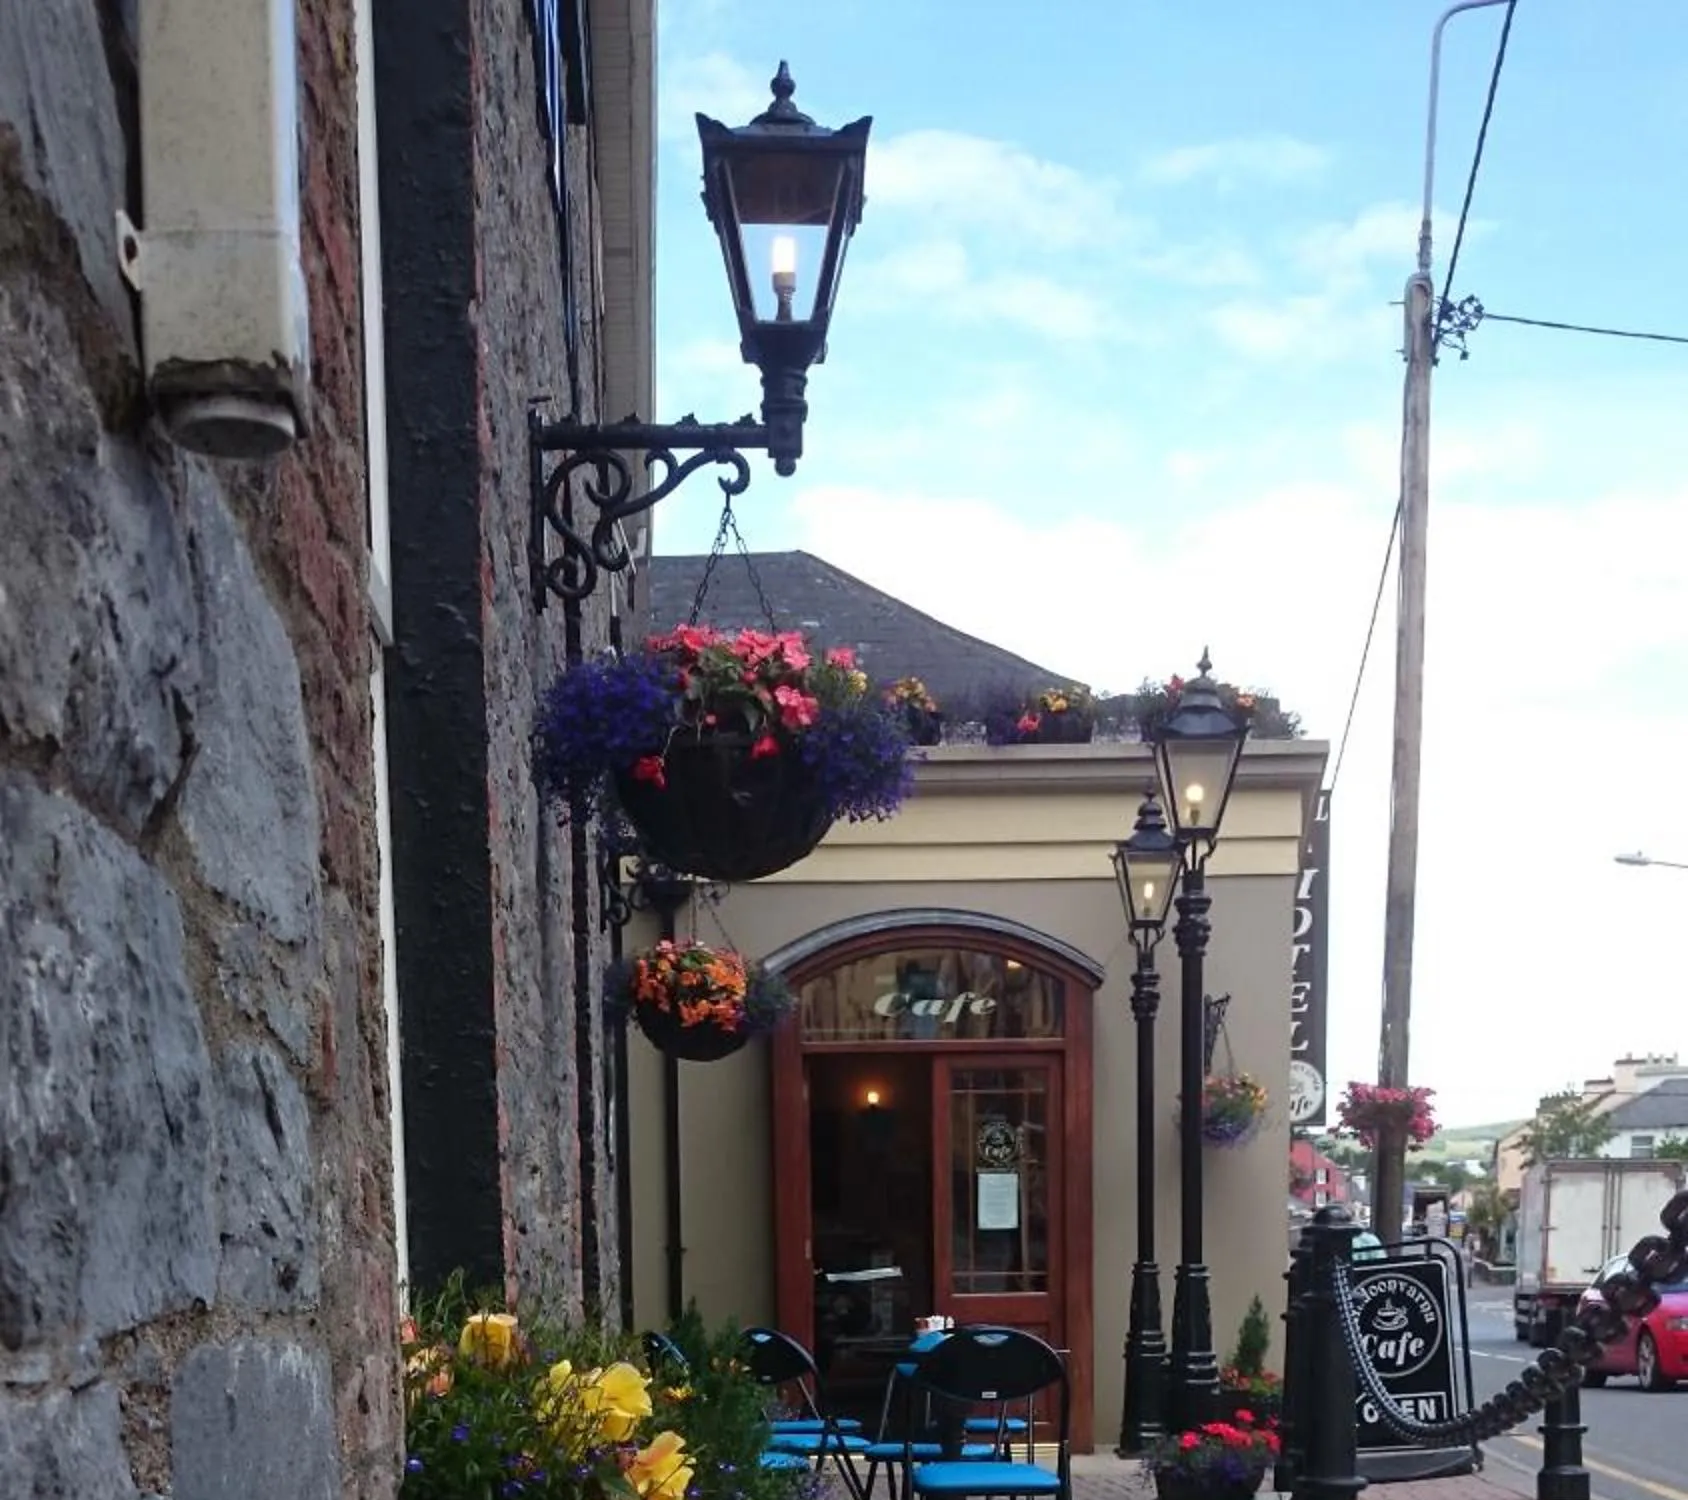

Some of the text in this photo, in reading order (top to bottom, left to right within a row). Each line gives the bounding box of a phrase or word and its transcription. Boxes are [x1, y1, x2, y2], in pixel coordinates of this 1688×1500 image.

[874, 991, 996, 1023] Cafe
[1290, 1095, 1313, 1117] fe
[1361, 1331, 1425, 1366] Cafe
[1363, 1398, 1436, 1423] OEN
